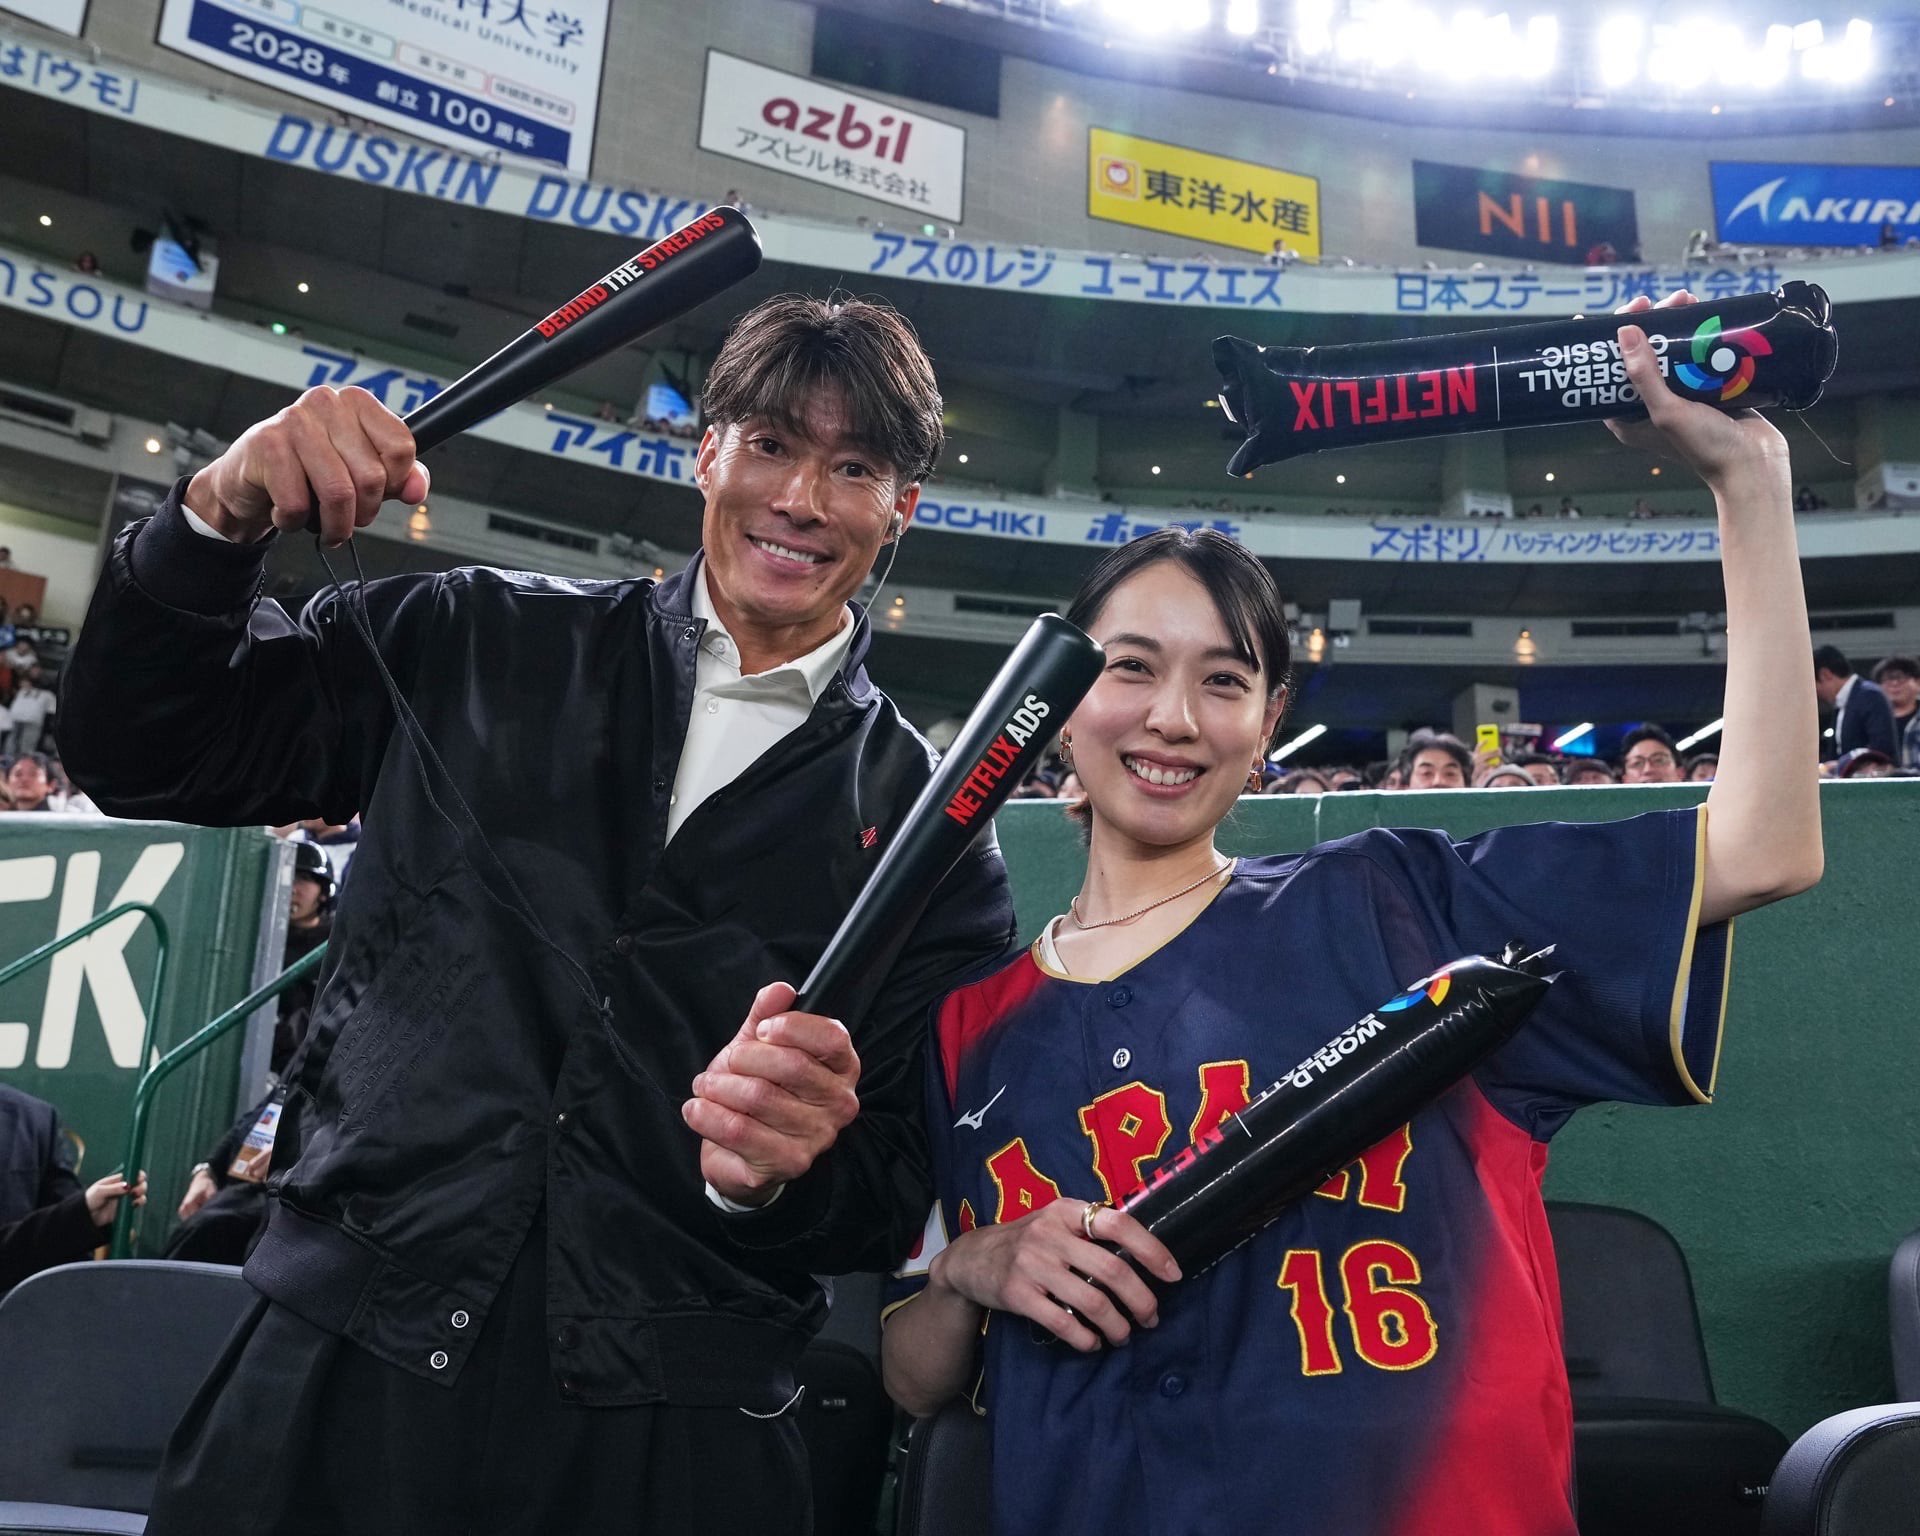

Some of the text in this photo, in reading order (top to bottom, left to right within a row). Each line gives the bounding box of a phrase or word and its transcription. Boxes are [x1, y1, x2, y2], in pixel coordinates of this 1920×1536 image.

[228, 23, 350, 84] 2028年
[478, 27, 579, 75] University
[762, 97, 912, 164] azbil
[736, 126, 931, 204] アズビル株式会社
[1144, 168, 1311, 236] 東洋水産
[537, 212, 726, 338] BEHIND THE STREAMS
[869, 231, 1283, 307] アスのレジ ユーエスエス
[1396, 267, 1784, 313] 日本ステージ株式会社
[1518, 356, 1669, 393] BSEBALL
[1541, 334, 1670, 368] CASSIC
[1289, 362, 1477, 432] NETFLIX
[1561, 383, 1642, 408] ORLD
[545, 413, 706, 484] アイホ
[944, 694, 1050, 826] NETFLIX ADS
[1292, 1019, 1387, 1088] WORLD
[1276, 1240, 1439, 1376] 16
